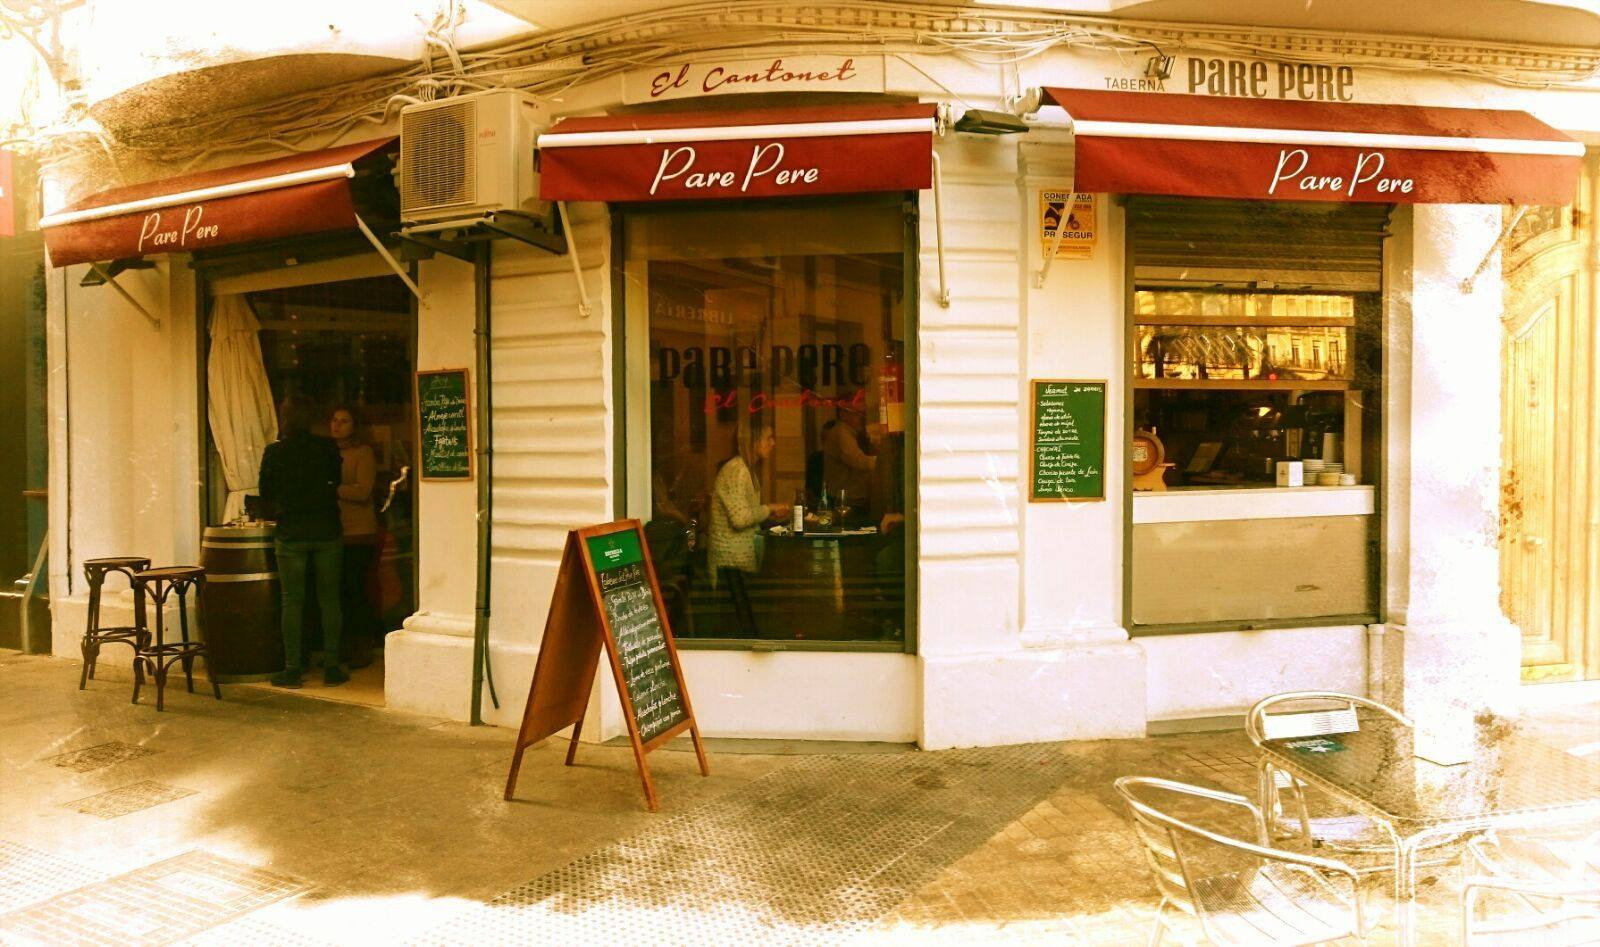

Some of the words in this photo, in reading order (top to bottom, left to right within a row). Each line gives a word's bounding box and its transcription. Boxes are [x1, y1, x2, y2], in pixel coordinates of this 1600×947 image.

[651, 63, 690, 97] El
[702, 58, 857, 92] Cantonet
[1104, 77, 1165, 92] TABERNA
[650, 146, 735, 195] Pare
[741, 142, 819, 192] Pere
[1268, 149, 1342, 195] Pare
[1348, 152, 1413, 197] Pere
[1044, 192, 1093, 200] CONEADA
[138, 212, 178, 252] Pare
[181, 206, 219, 246] Pere
[1044, 231, 1093, 239] PRSEGUR
[704, 388, 737, 416] El
